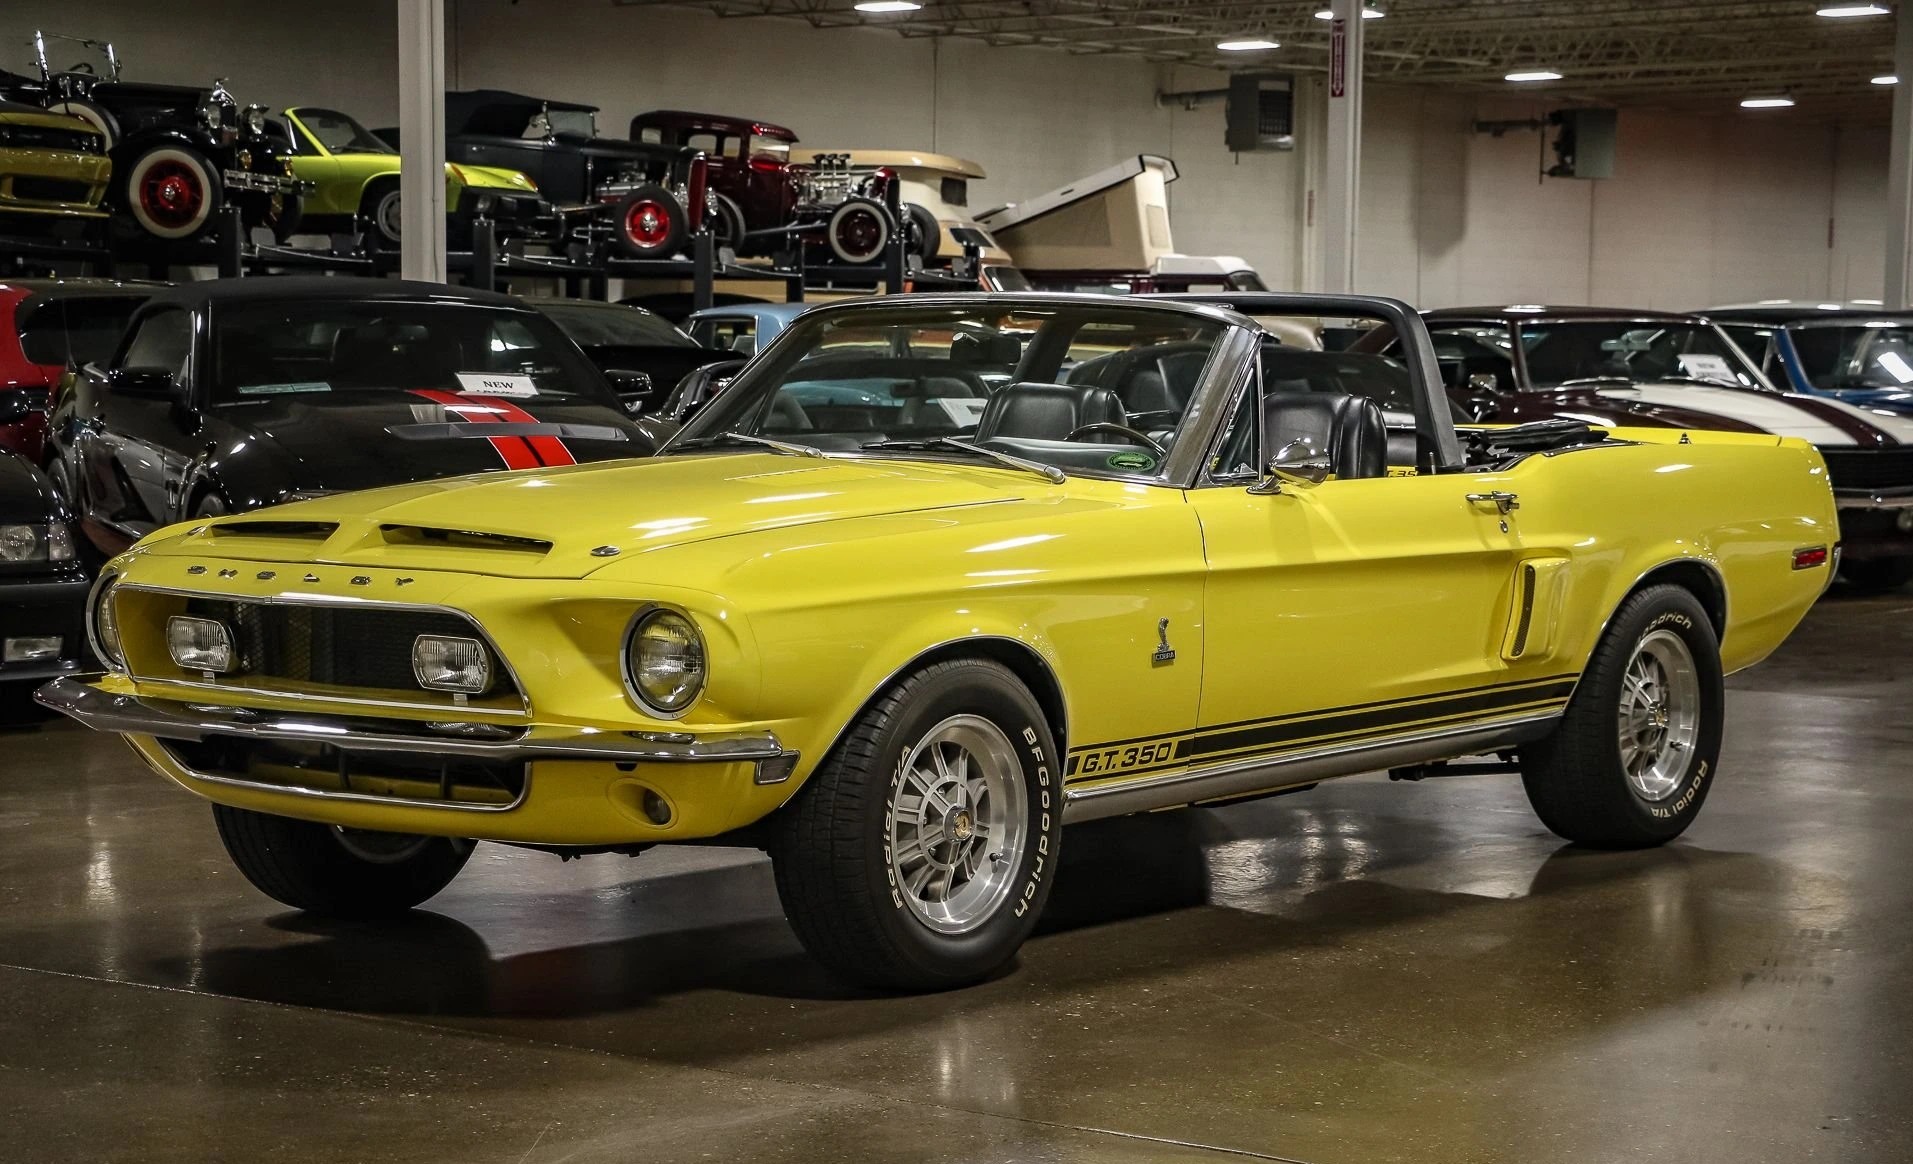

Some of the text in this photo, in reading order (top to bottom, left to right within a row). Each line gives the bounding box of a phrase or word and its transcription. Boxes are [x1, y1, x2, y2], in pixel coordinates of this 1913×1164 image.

[482, 380, 513, 389] NEW
[1155, 651, 1175, 660] COBRA
[1672, 760, 1708, 814] Radial
[1015, 727, 1050, 918] BFGoodrich
[884, 800, 903, 909] Radial
